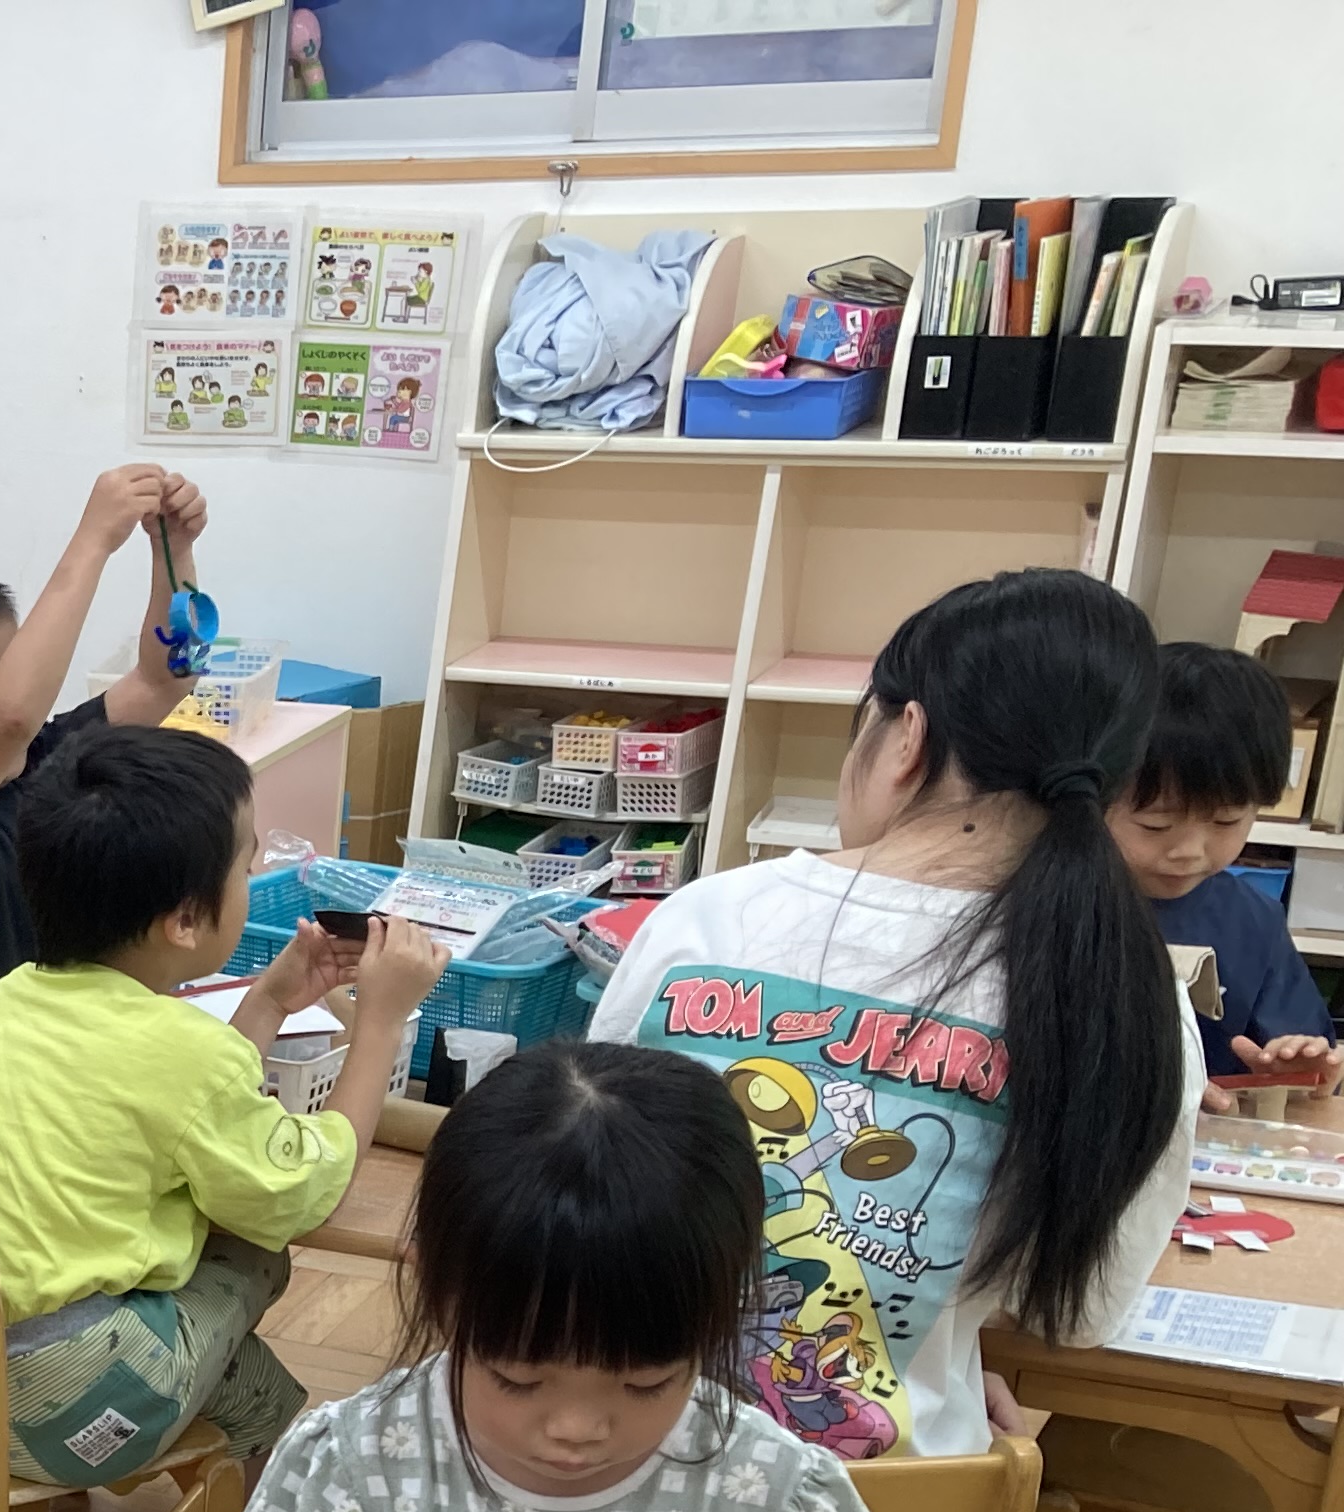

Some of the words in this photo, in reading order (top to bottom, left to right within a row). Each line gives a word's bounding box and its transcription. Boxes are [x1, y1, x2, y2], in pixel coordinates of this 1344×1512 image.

[302, 349, 367, 361] しょくじのやくそく
[660, 976, 765, 1039] TOM
[769, 1004, 845, 1041] and
[854, 1190, 928, 1238] Best
[814, 1210, 933, 1284] Friends!
